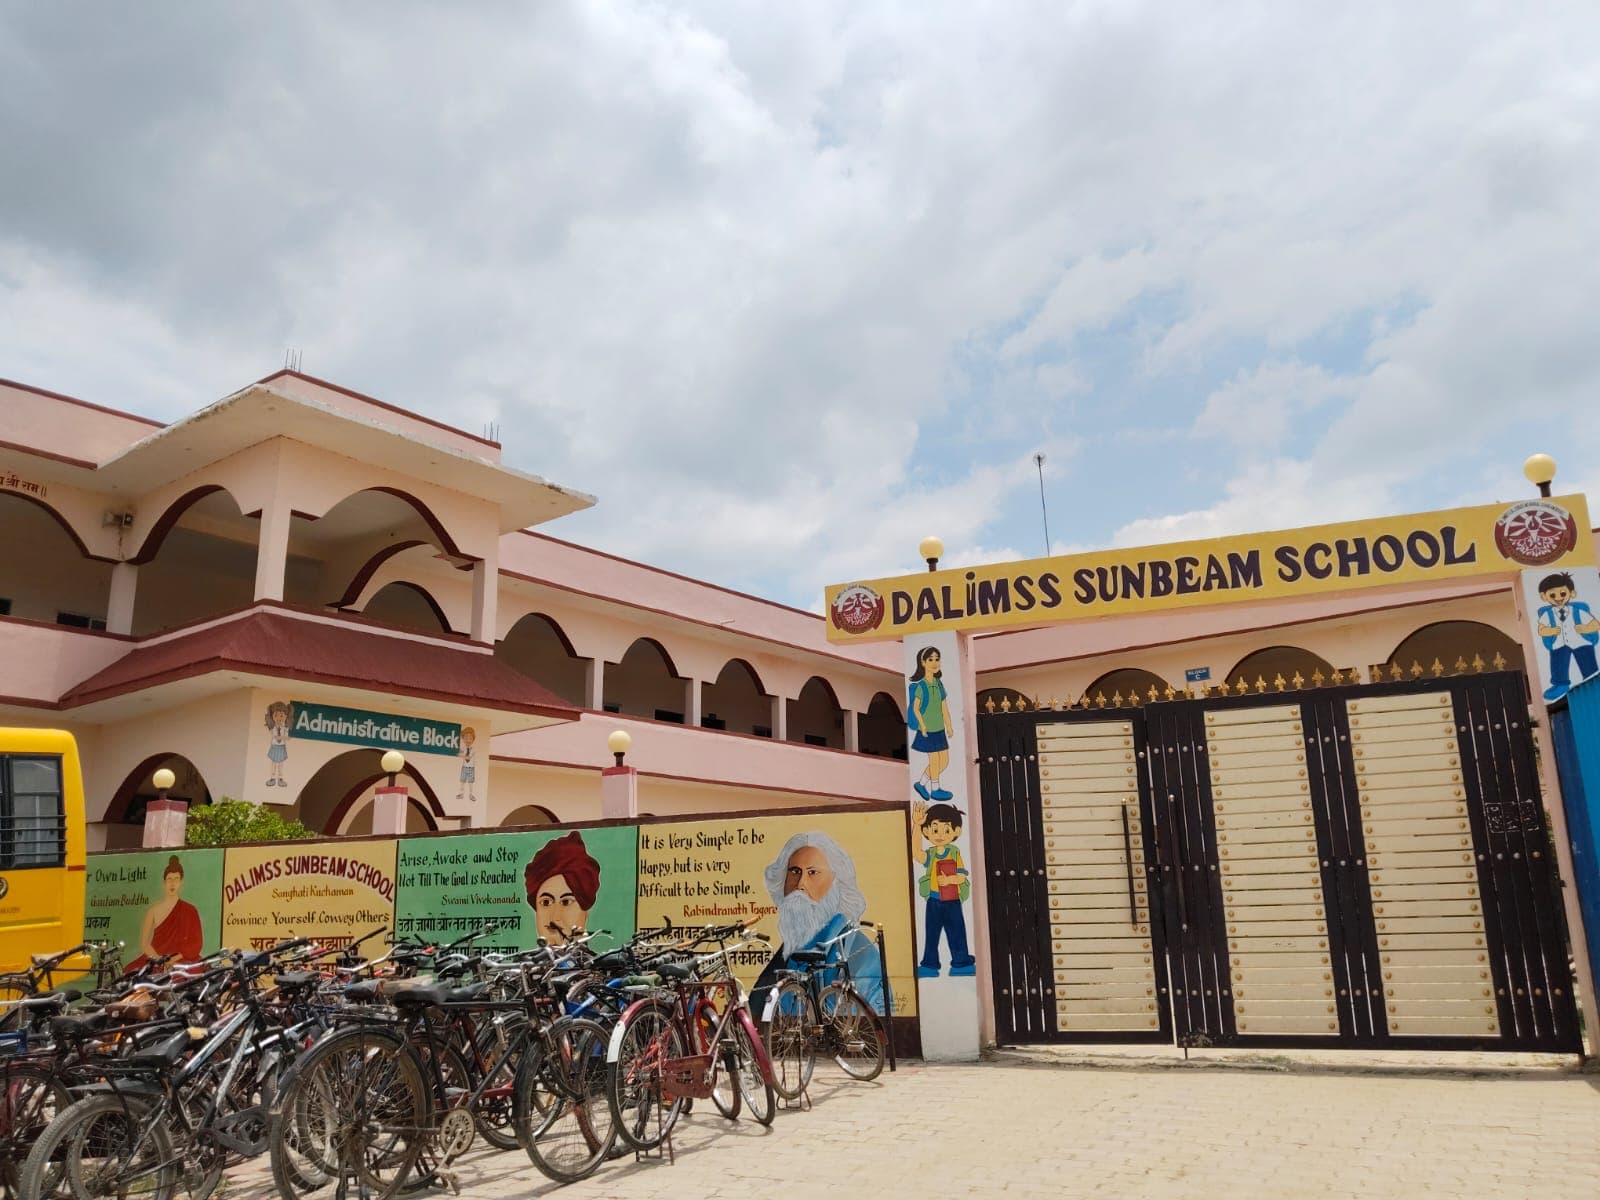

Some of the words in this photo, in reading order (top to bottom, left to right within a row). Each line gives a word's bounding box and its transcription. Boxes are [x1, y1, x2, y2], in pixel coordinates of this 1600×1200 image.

[1073, 550, 1264, 604] SUNBEAM
[1274, 526, 1476, 583] SCHOOL
[295, 710, 420, 745] Administrative
[423, 726, 461, 749] Block
[641, 834, 650, 849] It
[654, 836, 665, 850] is
[669, 832, 693, 850] Very
[696, 830, 734, 851] Simple
[736, 828, 749, 845] To
[751, 828, 765, 844] be
[432, 849, 468, 865] Awake
[473, 848, 493, 863] and
[496, 846, 519, 864] Stop
[95, 868, 118, 882] Own
[120, 866, 147, 882] Light
[674, 857, 691, 873] but
[694, 859, 703, 873] is
[706, 860, 730, 874] very
[225, 859, 282, 904] DALIMSS
[285, 855, 347, 876] SUNBEAM
[347, 859, 394, 903] SCHOOL
[418, 872, 432, 886] Till
[433, 872, 449, 886] The
[451, 870, 468, 886] Goal
[471, 873, 479, 885] is
[480, 869, 517, 884] Reached
[639, 882, 681, 898] Difficult
[684, 881, 695, 896] to
[697, 881, 710, 896] be
[120, 892, 149, 906] Buddha
[441, 894, 469, 906] Swami
[471, 892, 520, 904] Vivekananda
[226, 912, 268, 925] Convince
[356, 910, 390, 923] Others
[683, 903, 747, 918] Rabindranath
[749, 902, 778, 917] Tagore
